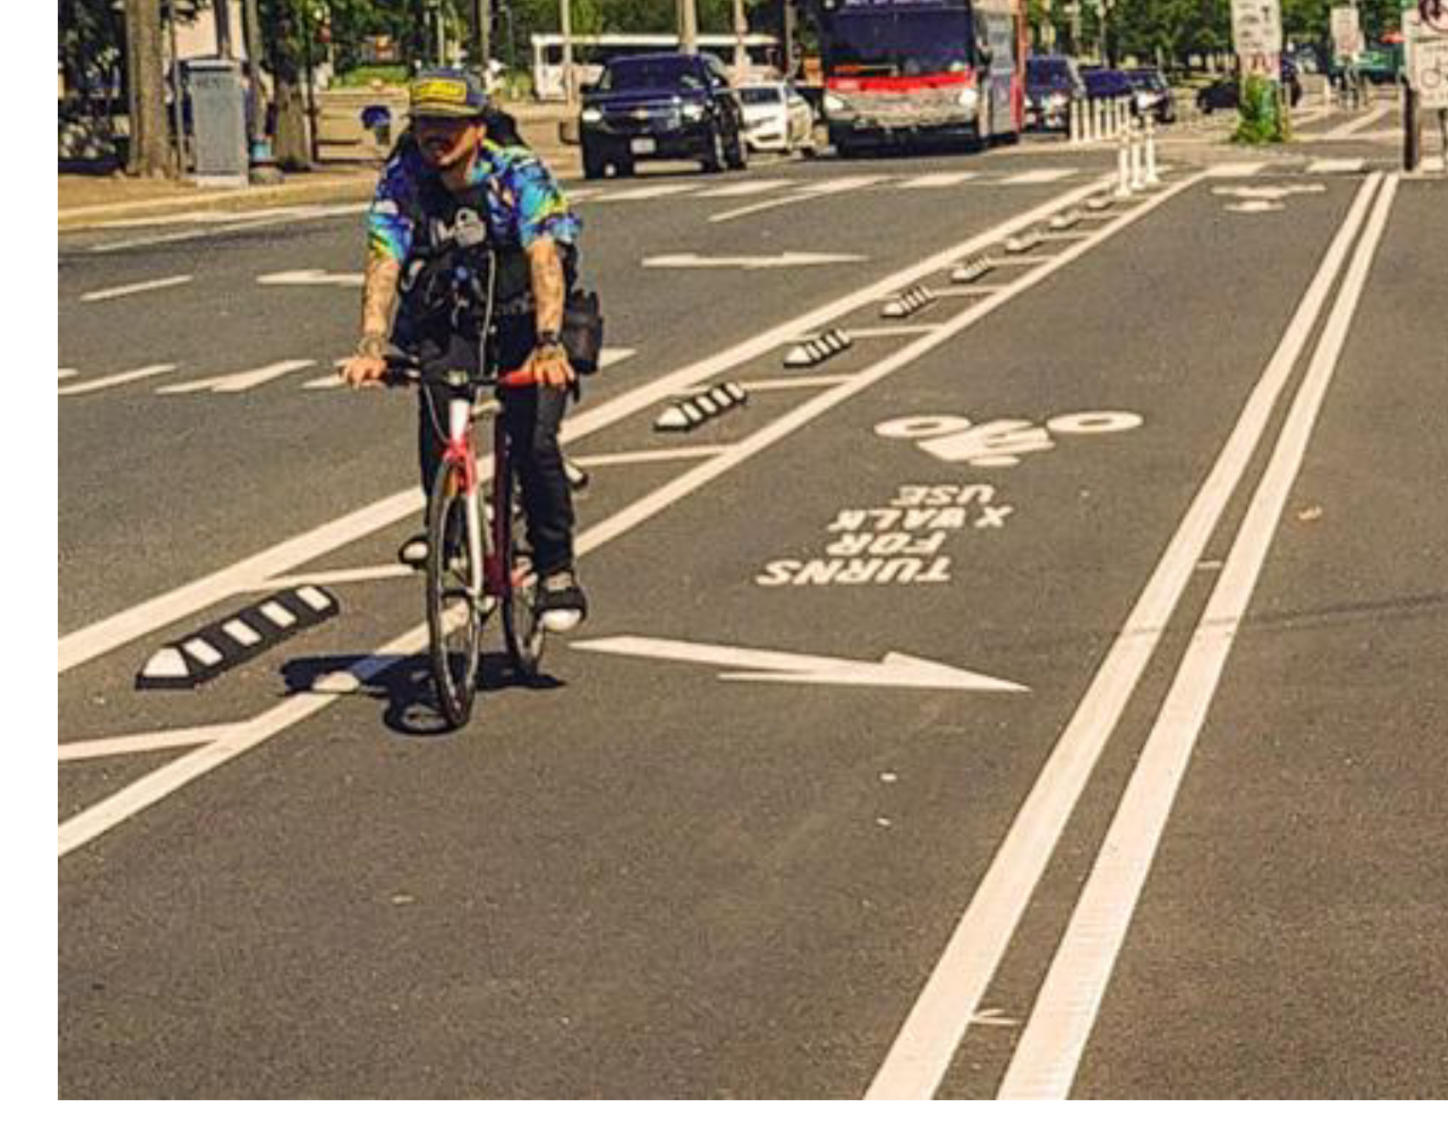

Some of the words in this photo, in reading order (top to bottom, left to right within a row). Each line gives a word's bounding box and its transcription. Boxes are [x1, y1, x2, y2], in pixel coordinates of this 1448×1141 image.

[890, 484, 996, 507] USE
[827, 507, 967, 532] WALK
[973, 506, 1014, 528] X
[825, 531, 947, 556] FOR
[755, 557, 952, 586] TURNS
